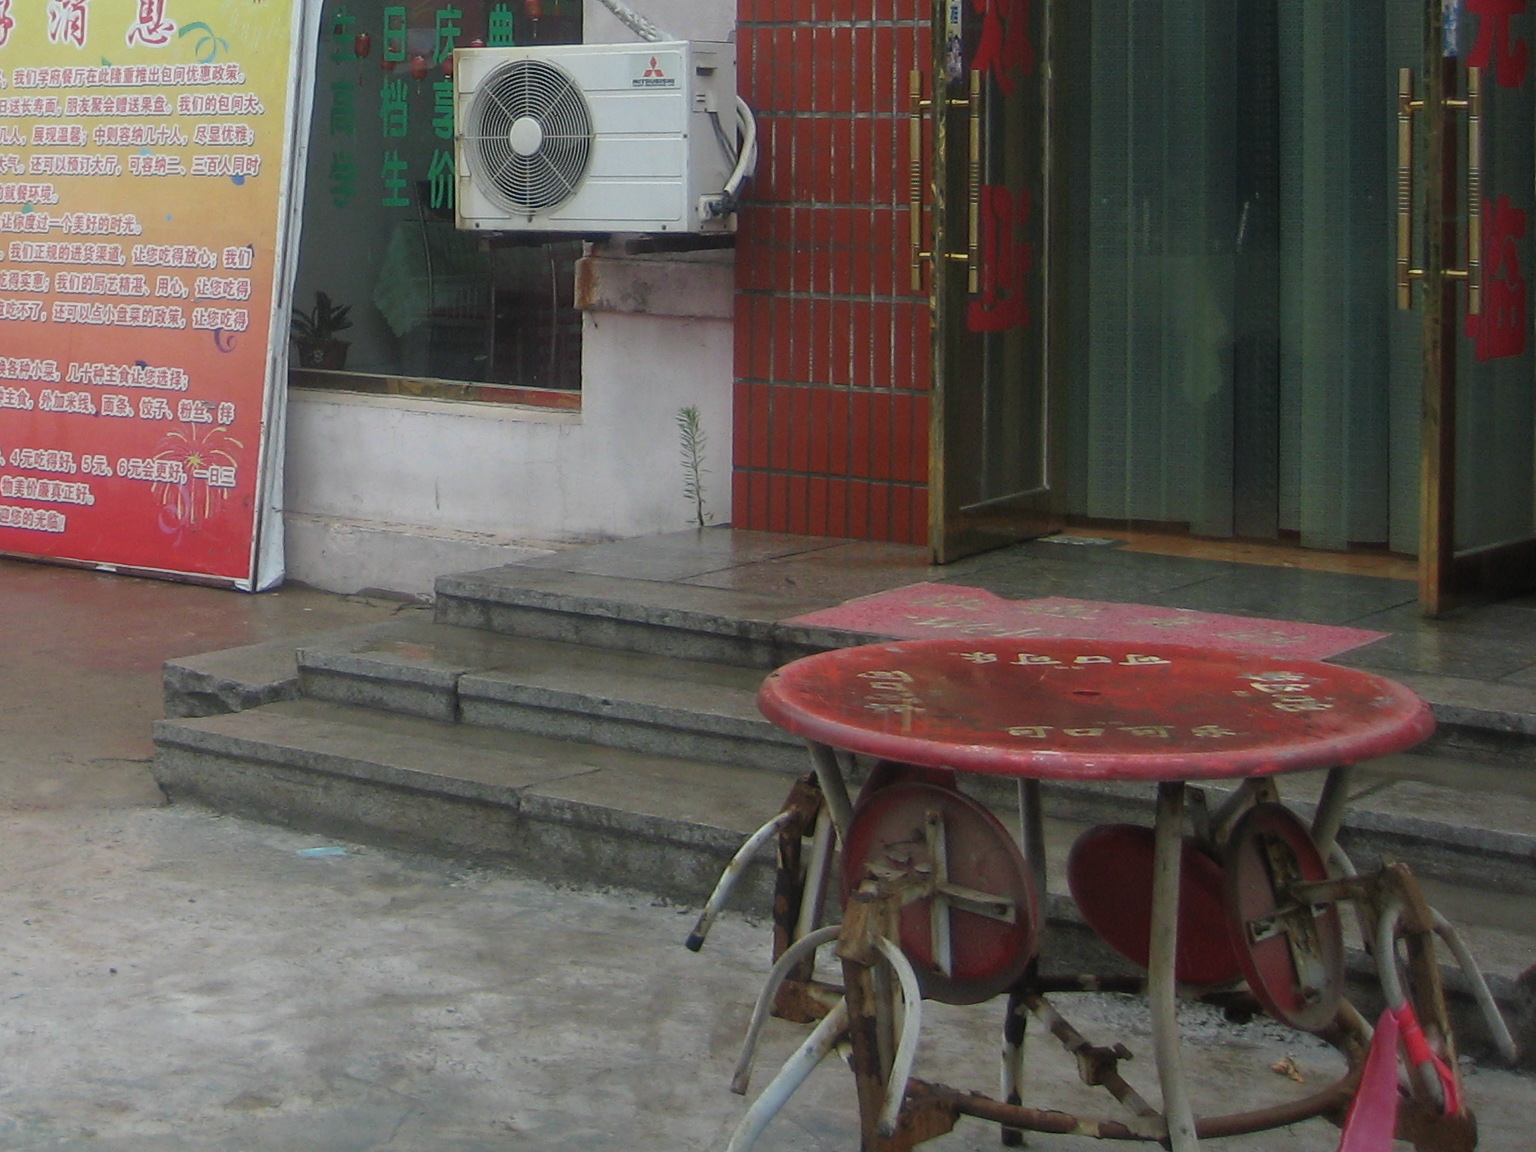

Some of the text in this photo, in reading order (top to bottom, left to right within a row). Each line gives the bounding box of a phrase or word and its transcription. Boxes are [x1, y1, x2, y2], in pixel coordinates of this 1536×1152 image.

[330, 79, 454, 139] 高档享
[330, 148, 456, 208] 学生价
